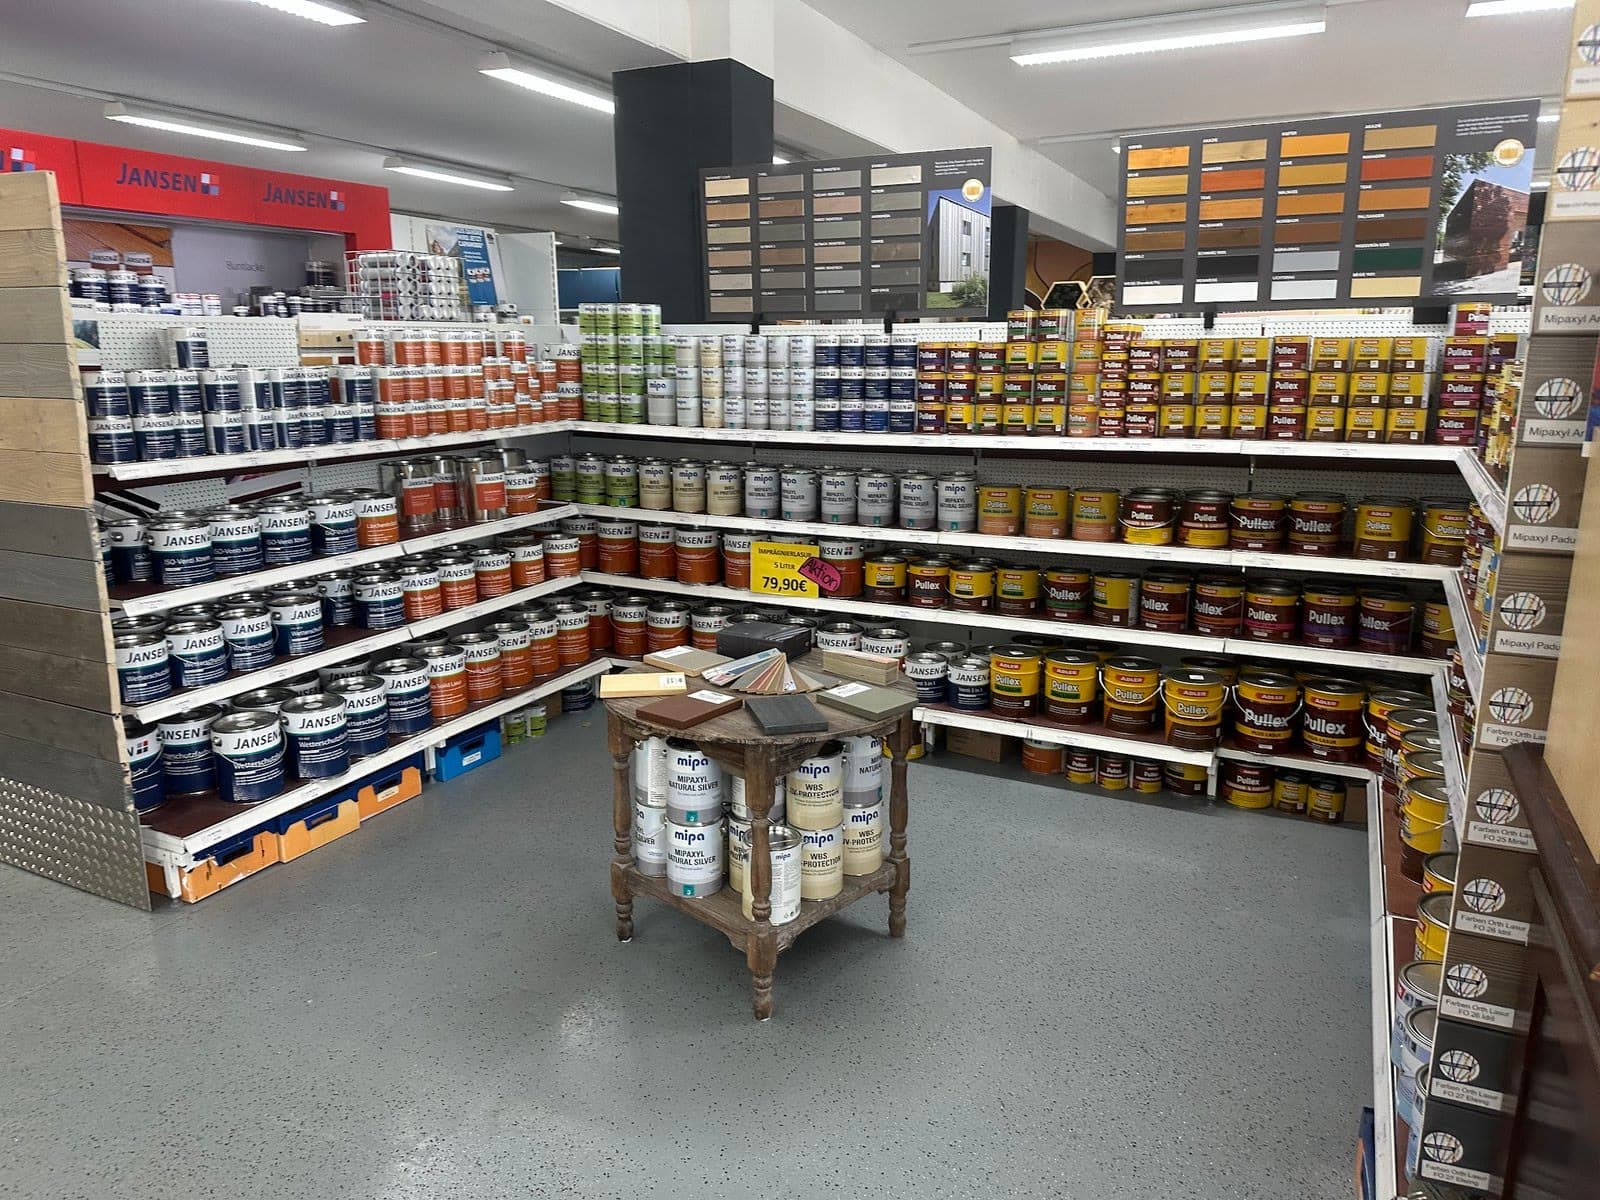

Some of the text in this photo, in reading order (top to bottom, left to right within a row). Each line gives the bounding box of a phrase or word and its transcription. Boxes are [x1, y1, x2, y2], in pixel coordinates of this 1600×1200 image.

[116, 162, 197, 194] JANSEN
[263, 182, 328, 209] JANSEN
[1544, 313, 1587, 326] Mipaxyl
[1275, 345, 1297, 356] Pullex
[1447, 347, 1473, 358] Pullex
[650, 380, 668, 392] mipa
[1275, 381, 1299, 391] Pullex
[1447, 383, 1474, 394] Pullex
[1273, 415, 1297, 426] Pullex
[1440, 418, 1465, 430] Pullex
[1528, 426, 1569, 440] Mipaxyl
[579, 462, 597, 473] mipa
[612, 464, 631, 476] mipa
[644, 466, 664, 478] mipa
[678, 469, 699, 480] mipa
[719, 472, 739, 483] mipa
[753, 473, 774, 485] mipa
[826, 478, 846, 490] mipa
[867, 479, 889, 491] mipa
[903, 481, 923, 493] mipa
[945, 483, 966, 495] mipa
[360, 503, 396, 514] JANSEN
[1131, 510, 1154, 522] Pullex
[1193, 512, 1217, 522] Pullex
[265, 517, 305, 529] JANSEN
[1239, 515, 1276, 530] Pullex
[1295, 517, 1332, 533] Pullex
[212, 525, 254, 538] JANSEN
[163, 534, 208, 548] JANSEN
[1512, 532, 1549, 544] Mipaxyl
[476, 558, 507, 569] JANSEN
[441, 568, 475, 579] JANSEN
[801, 557, 838, 591] Aktion
[404, 577, 439, 588] JANSEN
[762, 575, 808, 592] 79,90€
[915, 579, 941, 591] Pullex
[368, 586, 402, 599] JANSEN
[1049, 587, 1081, 602] Pullex
[1248, 607, 1278, 623] Pullex
[1309, 609, 1346, 626] Pullex
[232, 621, 270, 636] JANSEN
[183, 633, 222, 651] JANSEN
[1499, 637, 1535, 650] Mipaxyl
[909, 666, 940, 676] JANSEN
[999, 662, 1020, 670] ADLER
[389, 673, 428, 691] JANSEN
[956, 673, 987, 683] JANSEN
[995, 675, 1020, 687] Pullex
[1052, 680, 1079, 693] Pullex
[1115, 688, 1144, 701] Pullex
[1183, 689, 1207, 698] ADLER
[1260, 693, 1284, 701] ADLER
[1314, 698, 1338, 706] ADLER
[1177, 703, 1208, 716] Pullex
[300, 712, 344, 730] JANSEN
[1244, 708, 1289, 728] Pullex
[1304, 712, 1346, 736] Pullex
[1486, 726, 1532, 740] Farben Orth
[233, 731, 280, 750] JANSEN
[677, 755, 709, 771] mipa
[799, 762, 831, 778] mipa
[677, 775, 709, 784] MIPAXYL
[1236, 774, 1260, 786] Pullex
[669, 780, 719, 793] NATURAL SILVER
[805, 783, 824, 791] WBS
[851, 810, 879, 825] mipa
[859, 828, 875, 839] WBS
[1473, 824, 1519, 837] Farben Orth
[674, 829, 705, 846] mipa
[803, 832, 834, 848] mipa
[1483, 833, 1496, 842] FO
[674, 848, 705, 858] MIPAXYL
[775, 852, 791, 861] mipa
[810, 852, 828, 861] WBS
[668, 854, 716, 867] NATURAL SILVER
[1461, 913, 1487, 925] Farben
[1487, 918, 1504, 928] Orth
[1473, 924, 1486, 933] FO
[1445, 999, 1471, 1010] Farben
[1471, 1003, 1489, 1013] Orth
[1458, 1007, 1470, 1017] FO
[1435, 1081, 1461, 1093] Farben
